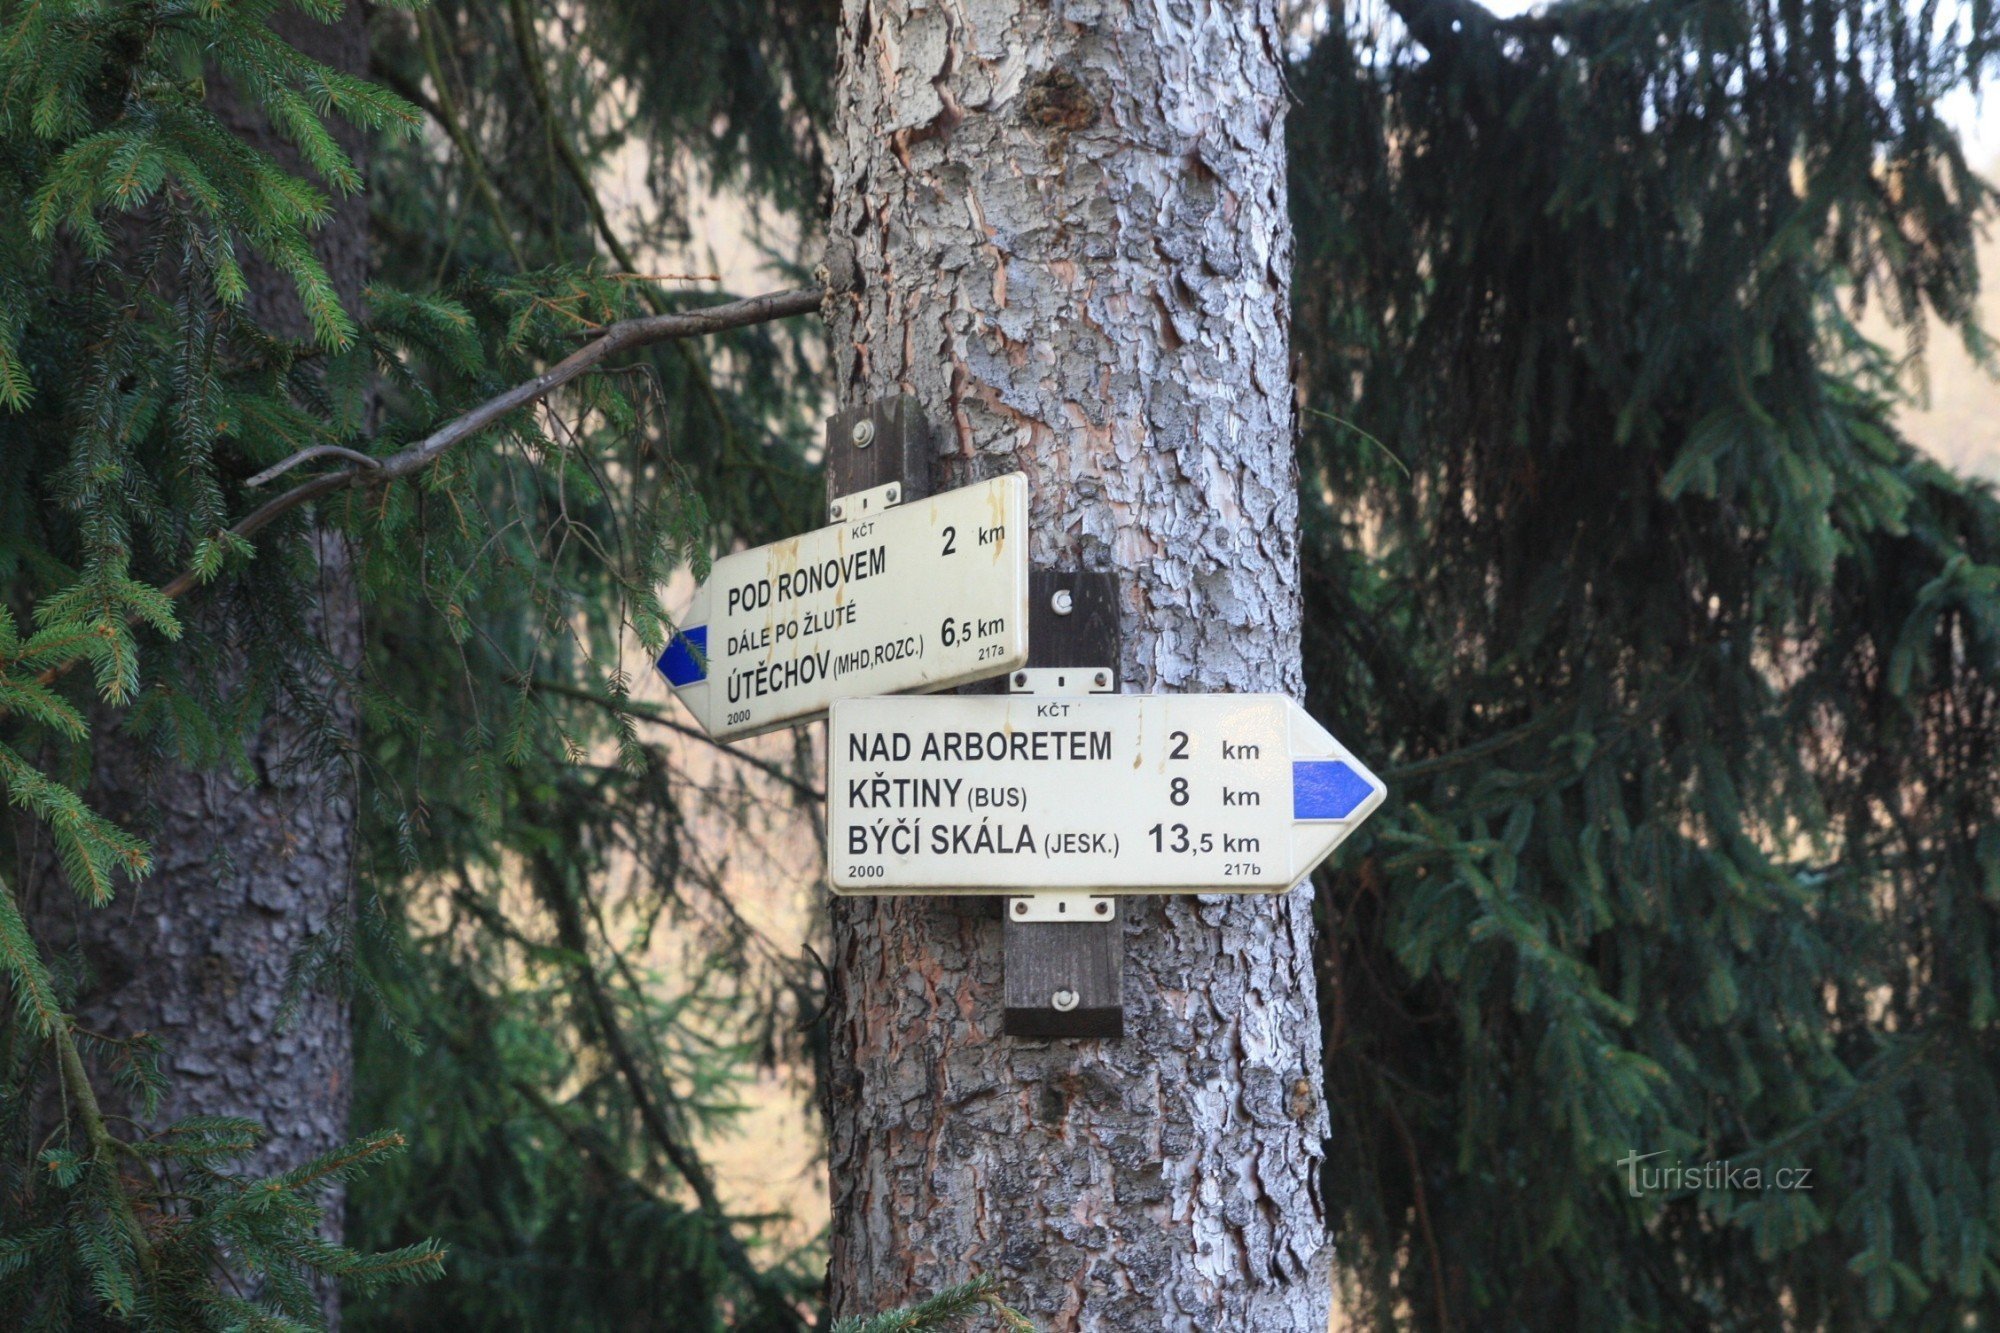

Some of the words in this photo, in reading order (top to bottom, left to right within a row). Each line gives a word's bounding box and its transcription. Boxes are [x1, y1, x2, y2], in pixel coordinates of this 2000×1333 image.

[851, 522, 875, 539] KČT
[728, 578, 772, 616] POD
[778, 545, 886, 602] RONOVEM
[941, 526, 956, 556] 2
[978, 523, 1005, 546] km
[728, 627, 770, 656] DÁLE
[776, 619, 798, 643] PO
[803, 602, 857, 636] ŽLUTÉ
[728, 650, 831, 703] ÚTĚCHOV
[978, 616, 1005, 638] km
[978, 645, 1004, 661] 217a
[727, 709, 751, 725] 2000
[1037, 703, 1070, 718] KČT
[848, 732, 912, 761] NAD
[922, 731, 1113, 761] ARBORETEM
[1168, 731, 1190, 760] 2
[1222, 740, 1260, 760] km
[848, 772, 963, 808] KŘTINY
[1169, 777, 1190, 806] 8
[1223, 787, 1260, 807] km
[848, 816, 920, 855] BÝČÍ
[931, 816, 1037, 854] SKÁLA
[1223, 833, 1260, 853] km
[848, 865, 884, 878] 2000
[1224, 862, 1261, 876] 217b
